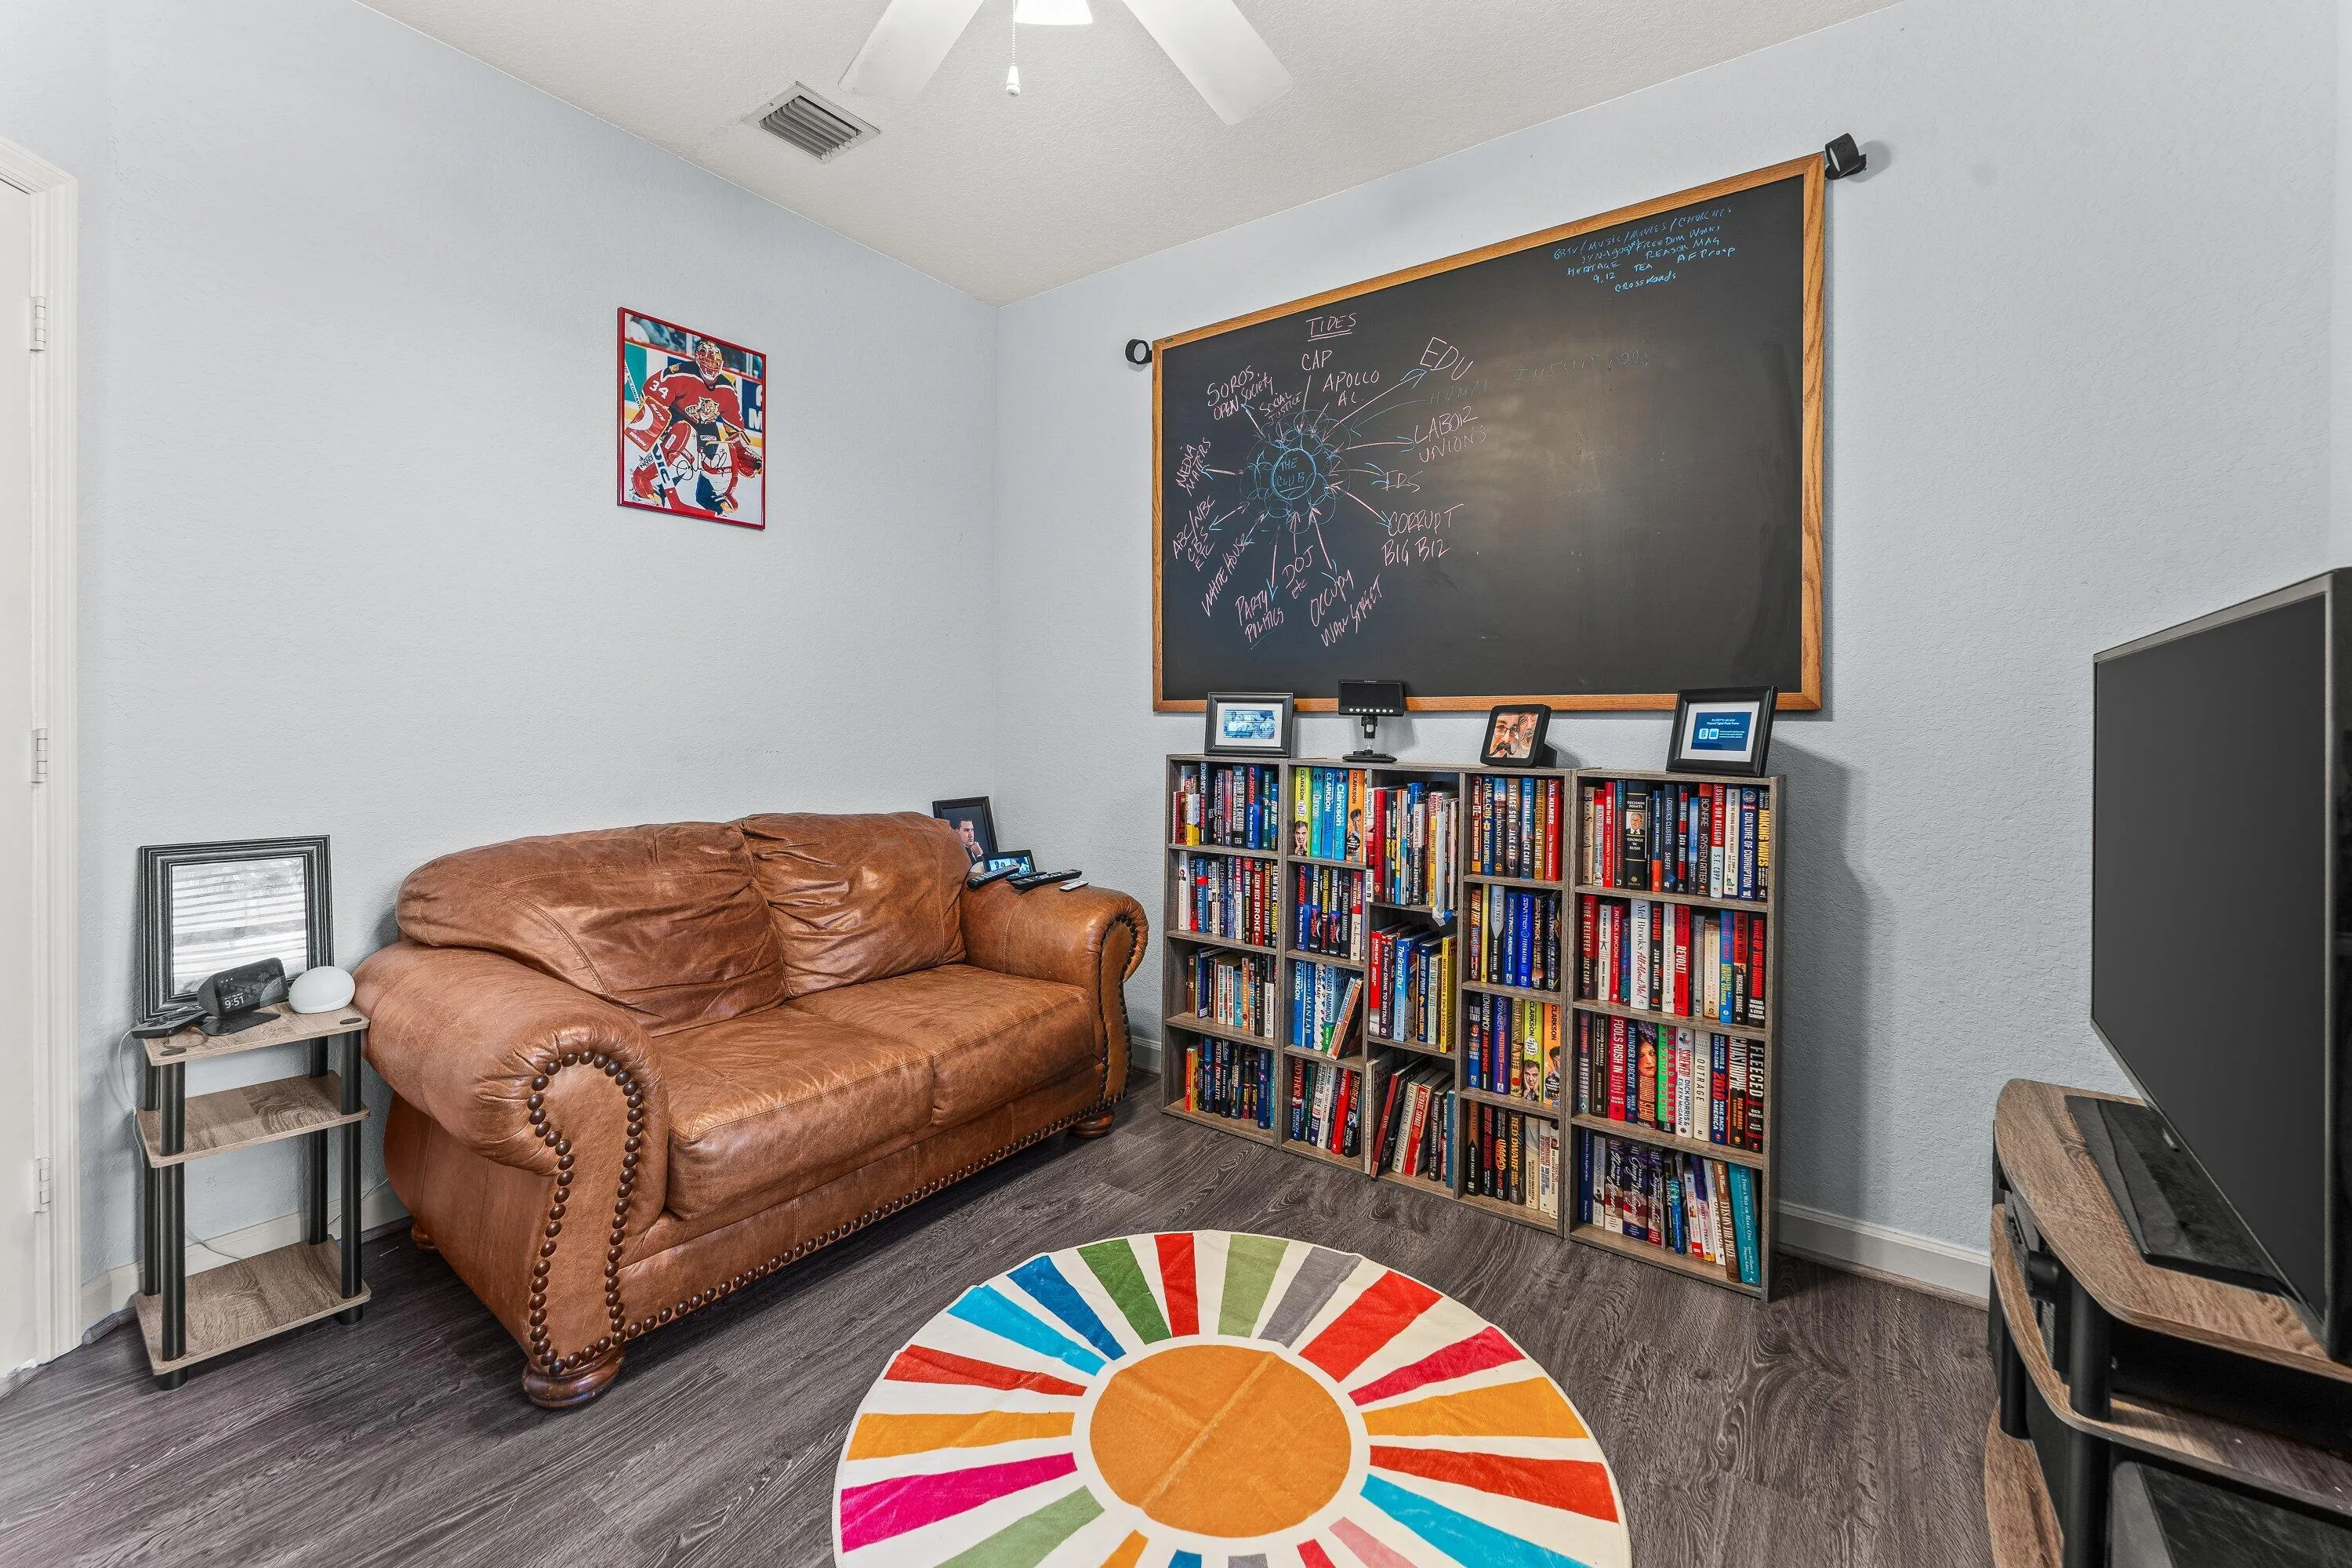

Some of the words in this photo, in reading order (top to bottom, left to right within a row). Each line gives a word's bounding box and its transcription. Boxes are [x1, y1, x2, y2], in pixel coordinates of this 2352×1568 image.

[1634, 263, 1653, 273] TEA
[1305, 312, 1357, 336] TIDES
[1301, 350, 1333, 371] CAP
[1420, 337, 1474, 381] EDU
[649, 380, 669, 399] 34
[1207, 365, 1256, 407] SOROS
[1322, 370, 1380, 393] APOLLO
[1214, 395, 1239, 420] OPEN
[1259, 391, 1293, 416] SOCIAL
[1414, 406, 1479, 445] LABOR
[630, 432, 647, 447] BROWN
[1419, 425, 1486, 463] UNIONS
[1175, 444, 1196, 488] MEDIA
[1277, 457, 1298, 471] THE
[1276, 472, 1305, 488] CLUB
[1388, 503, 1465, 538] CORRUPT
[1188, 526, 1209, 562] CBS
[1381, 539, 1410, 567] BIG
[1281, 544, 1314, 589] DOJ
[1201, 566, 1228, 618] WHITE
[1310, 569, 1355, 627] OCCUPY
[1235, 590, 1269, 627] PARTY
[1245, 607, 1284, 644] POLITICS
[1336, 784, 1345, 826] Clarkson
[1744, 813, 1753, 840] CULTURE
[1759, 810, 1769, 840] MAKING
[1758, 841, 1769, 866] WAVES
[1744, 850, 1752, 887] CORRUPTION
[1472, 895, 1481, 911] STAR
[1638, 904, 1646, 920] Mel
[1472, 912, 1480, 927] TREK
[1637, 921, 1646, 952] Brooks
[1676, 946, 1686, 974] REVOLT!
[1751, 967, 1762, 998] MORNING
[224, 996, 244, 1009] 9:51
[1613, 1019, 1624, 1042] FOOLS
[1613, 1044, 1624, 1064] RUSH
[1580, 1058, 1588, 1098] DANGEROUS
[1697, 1058, 1705, 1102] OUTRAGE
[1749, 1045, 1764, 1098] FLEECED
[1350, 1076, 1361, 1110] TRIGGERED
[1417, 1090, 1426, 1110] MICHAEL
[1640, 1076, 1655, 1101] HOWARD
[1414, 1110, 1423, 1127] SAVAGE
[1721, 1201, 1730, 1215] EYES
[1722, 1217, 1731, 1225] ON
[1723, 1227, 1733, 1240] THE
